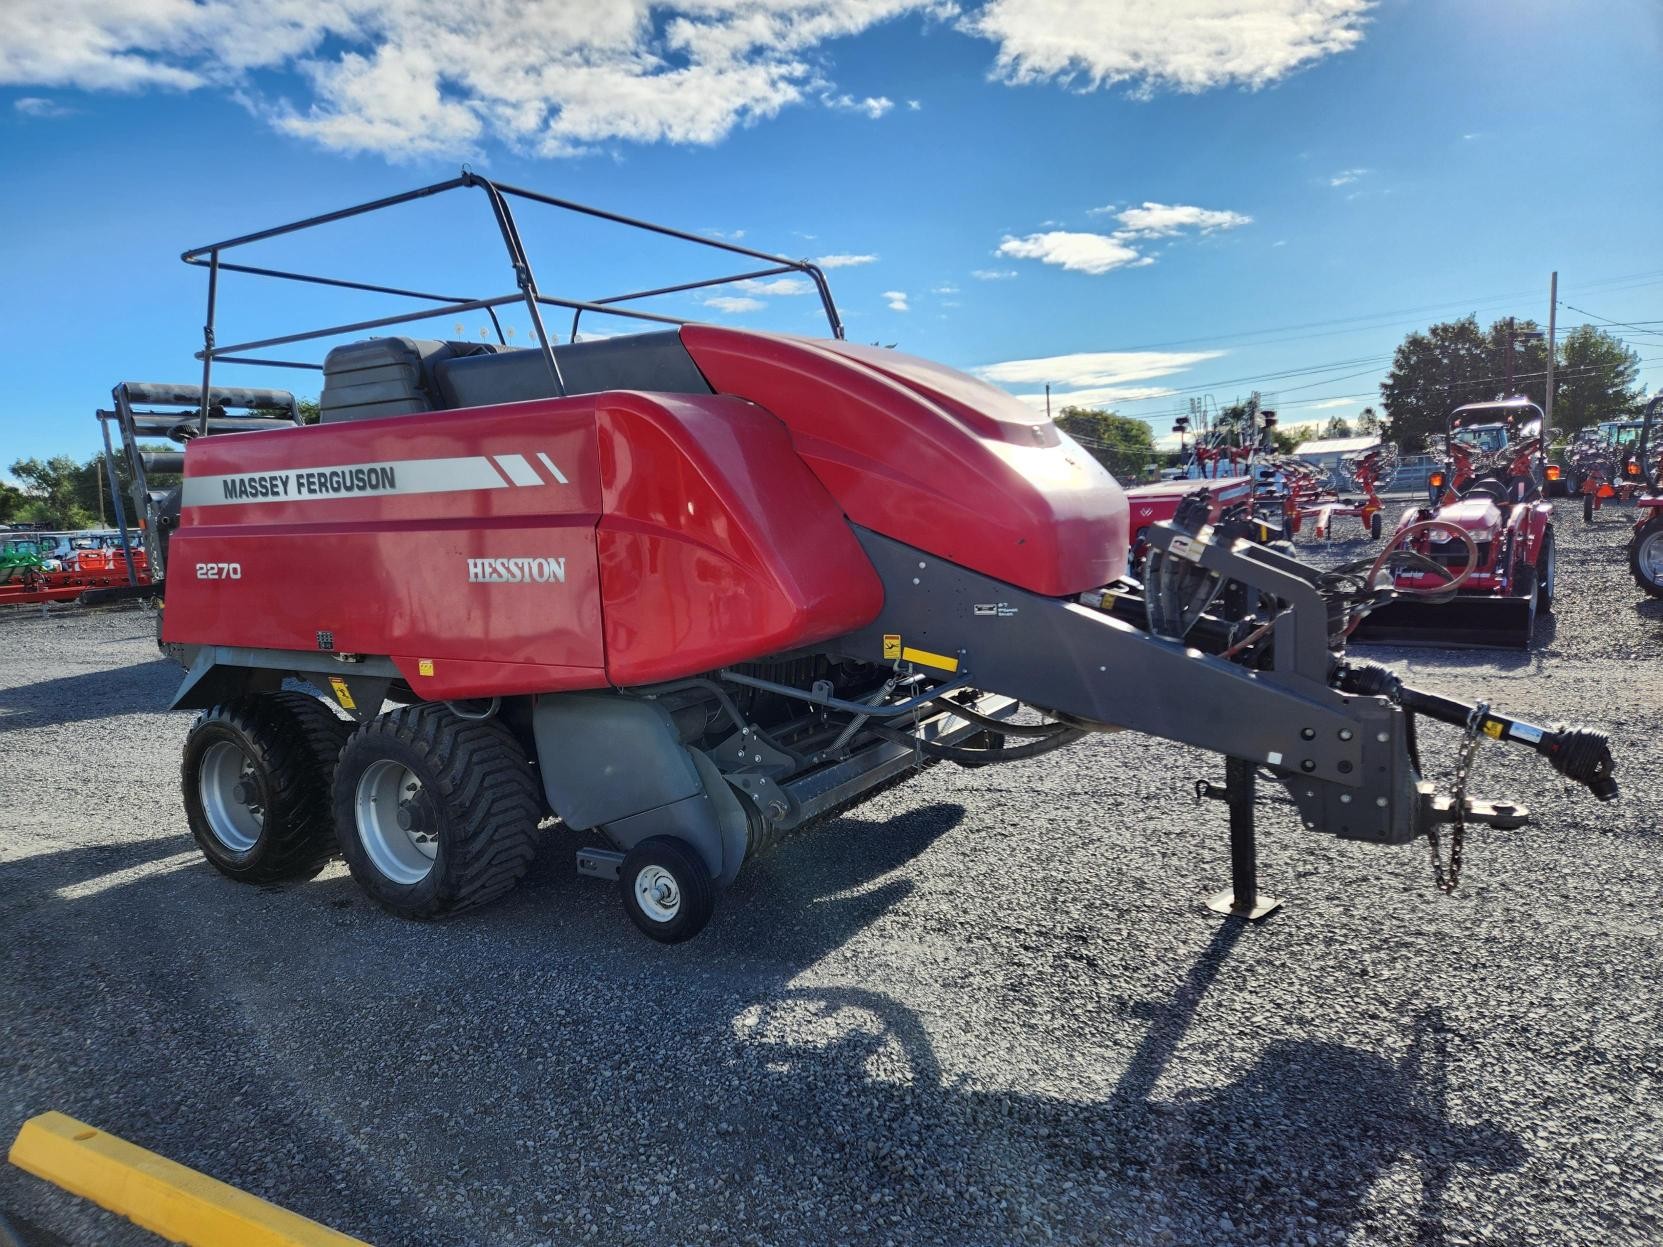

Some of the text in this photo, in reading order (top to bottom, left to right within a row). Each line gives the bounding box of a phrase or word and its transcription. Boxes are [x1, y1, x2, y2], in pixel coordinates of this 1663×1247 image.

[222, 466, 396, 499] MASSEY FERGUSON
[195, 563, 242, 580] 2270
[467, 557, 566, 583] HESSTON
